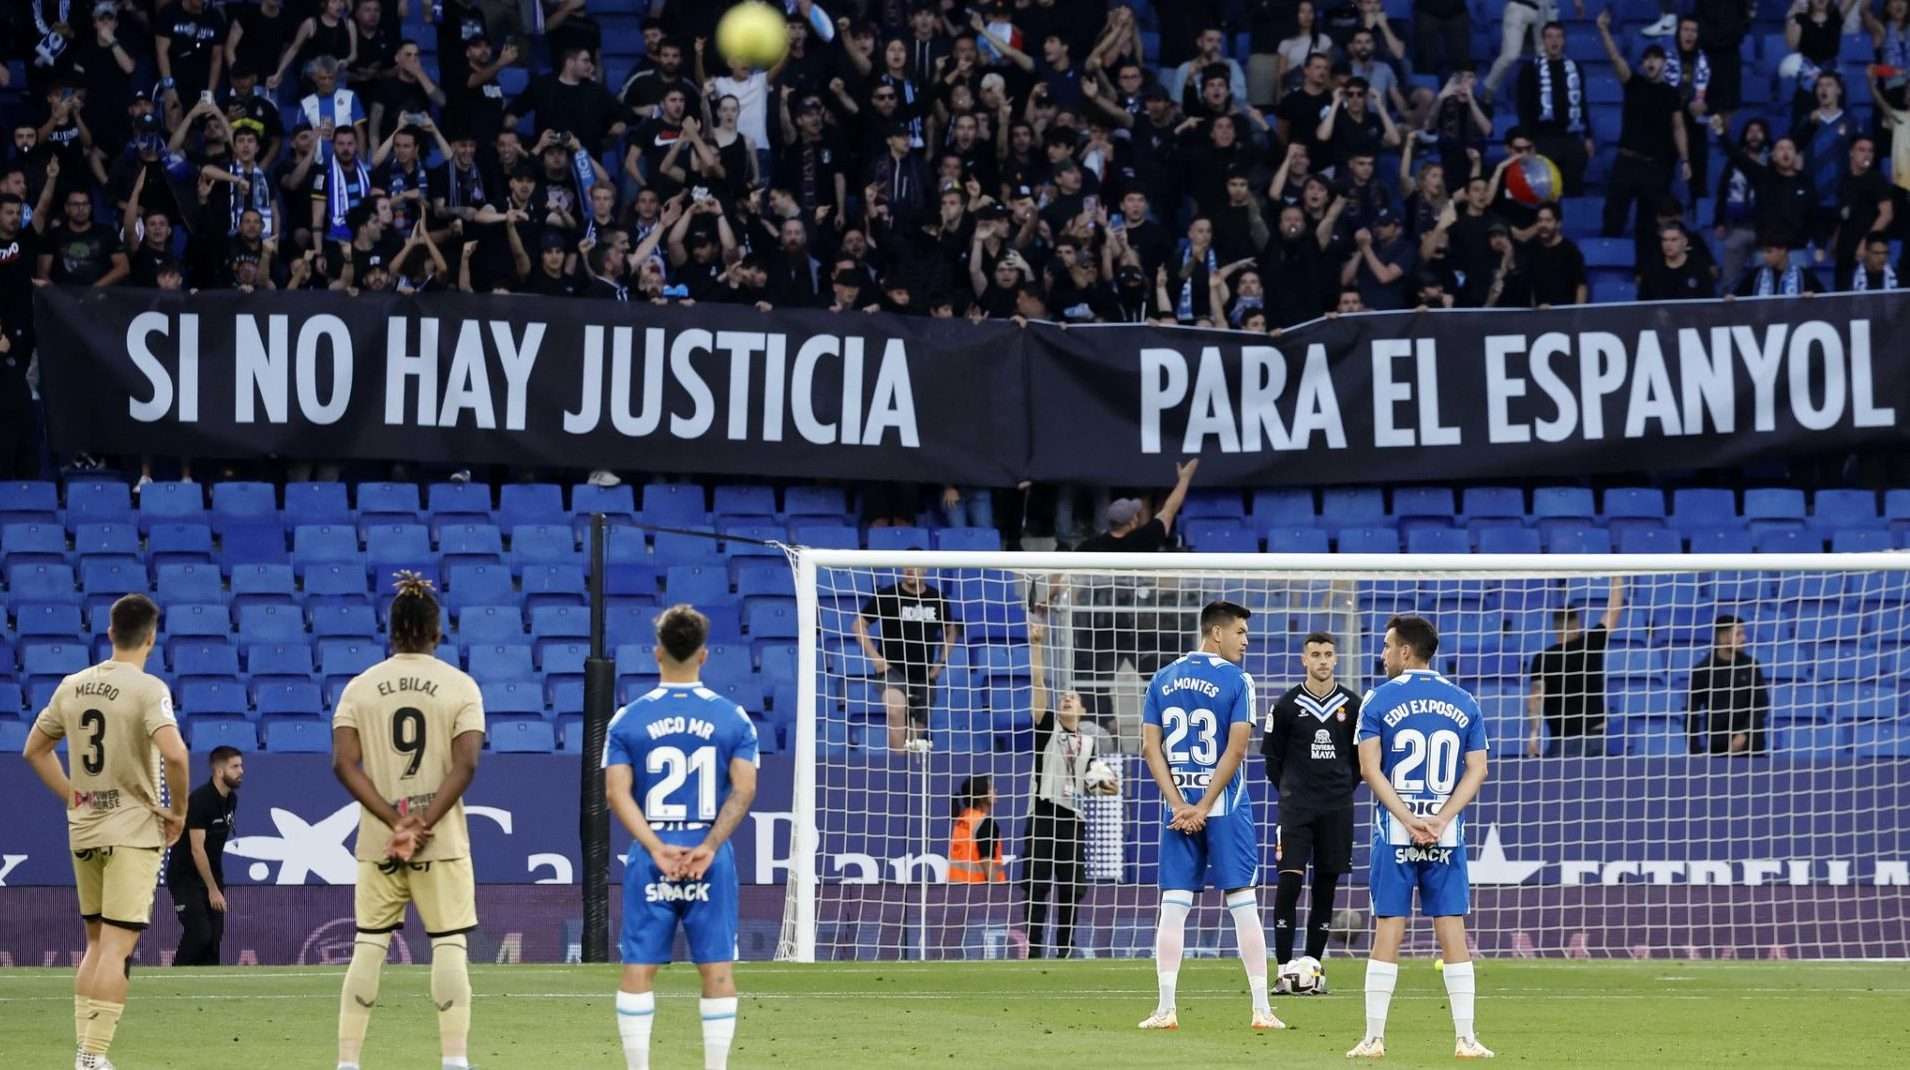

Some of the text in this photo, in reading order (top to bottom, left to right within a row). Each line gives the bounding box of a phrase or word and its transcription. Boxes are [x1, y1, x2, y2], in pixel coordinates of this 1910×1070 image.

[127, 312, 921, 448] SI NO HAY JUSTICIA
[1140, 318, 1895, 454] PARA EL ESPANYOL
[75, 682, 119, 701] MELERO
[377, 677, 439, 698] EL BILAL
[1383, 703, 1409, 728] EDU
[80, 709, 105, 777] 3
[388, 707, 426, 780] 9
[646, 716, 715, 740] NICO MR
[1161, 706, 1217, 766] 23
[1310, 750, 1337, 759] MAYA
[645, 746, 717, 820] 21
[1391, 728, 1461, 795] 20
